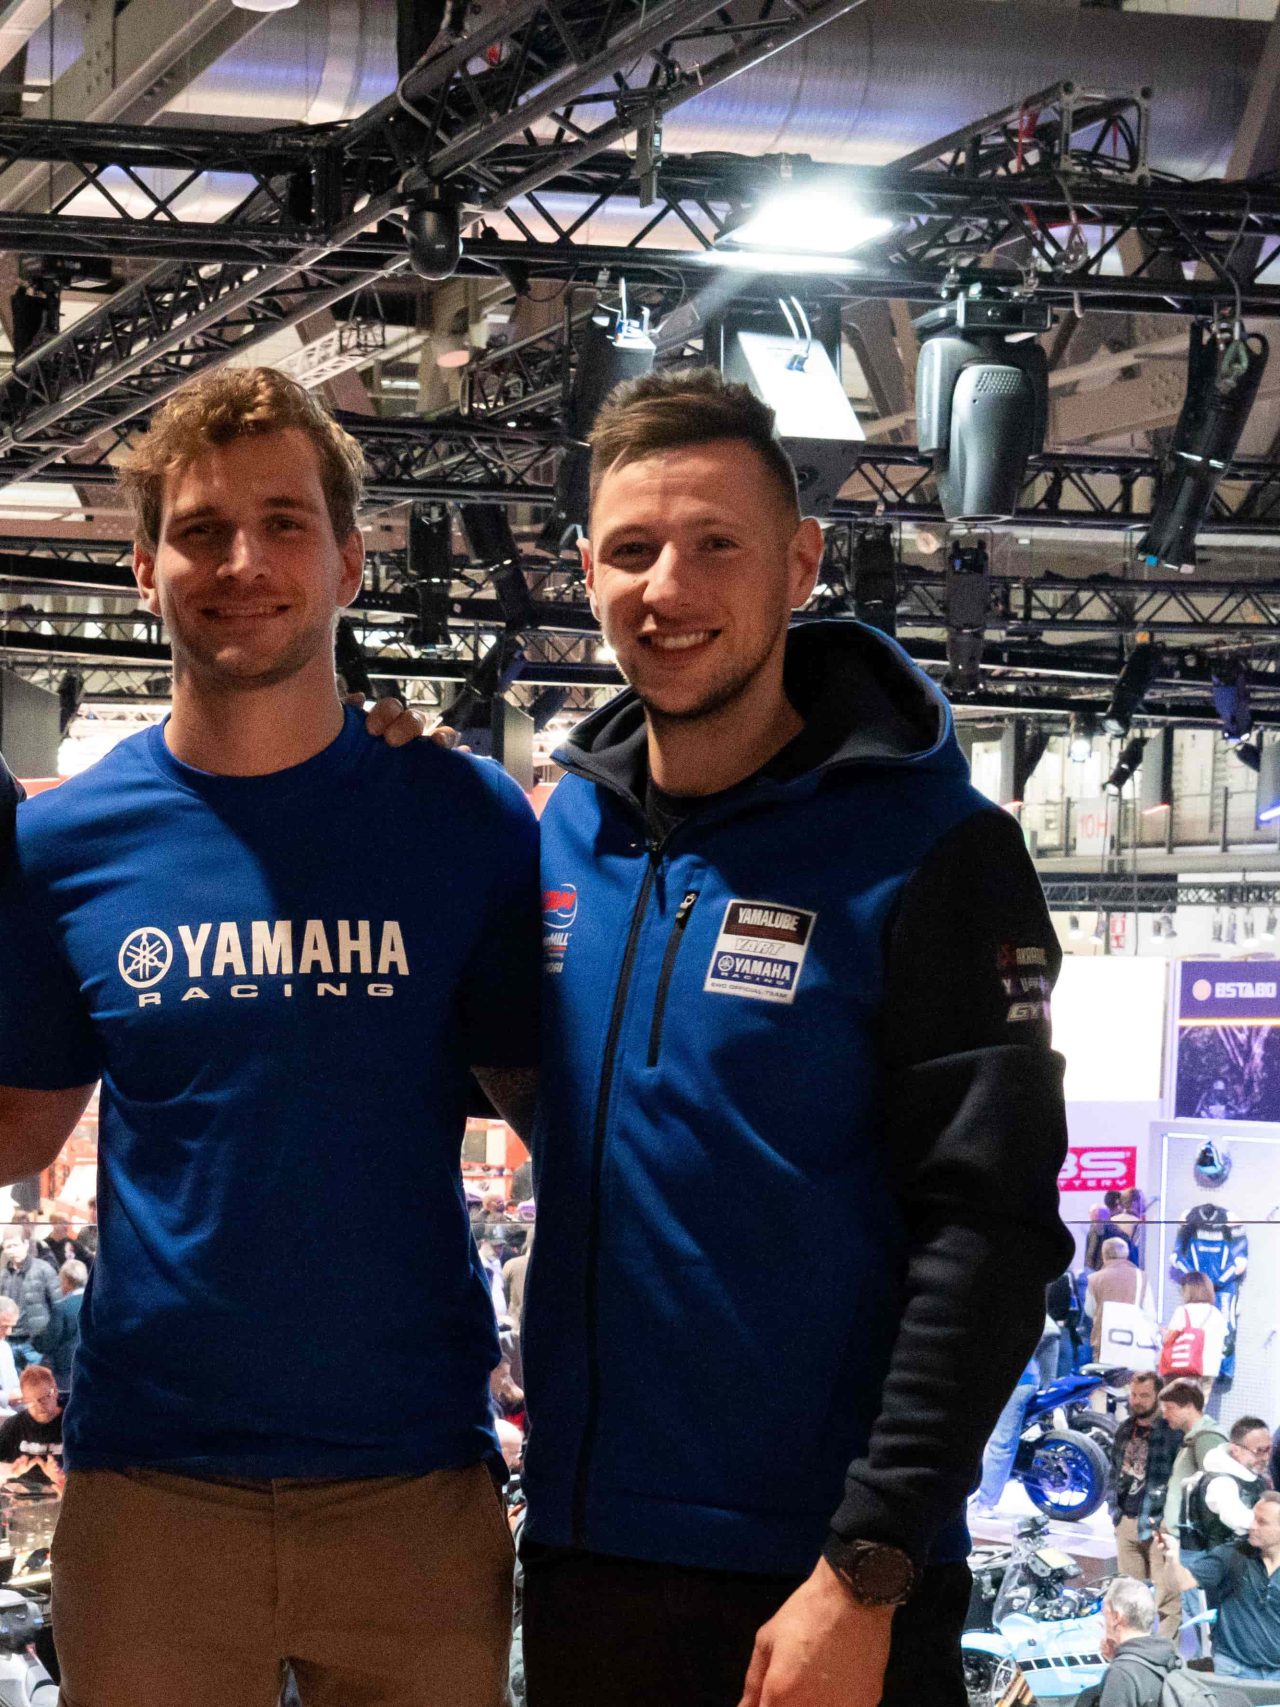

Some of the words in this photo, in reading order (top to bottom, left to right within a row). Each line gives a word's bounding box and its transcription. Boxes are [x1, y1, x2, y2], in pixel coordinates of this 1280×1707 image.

[738, 907, 800, 932] YAMALUBE
[178, 919, 410, 978] YAMAHA
[735, 938, 785, 956] YART
[735, 957, 791, 981] YAMAHA
[138, 982, 395, 1008] RACING
